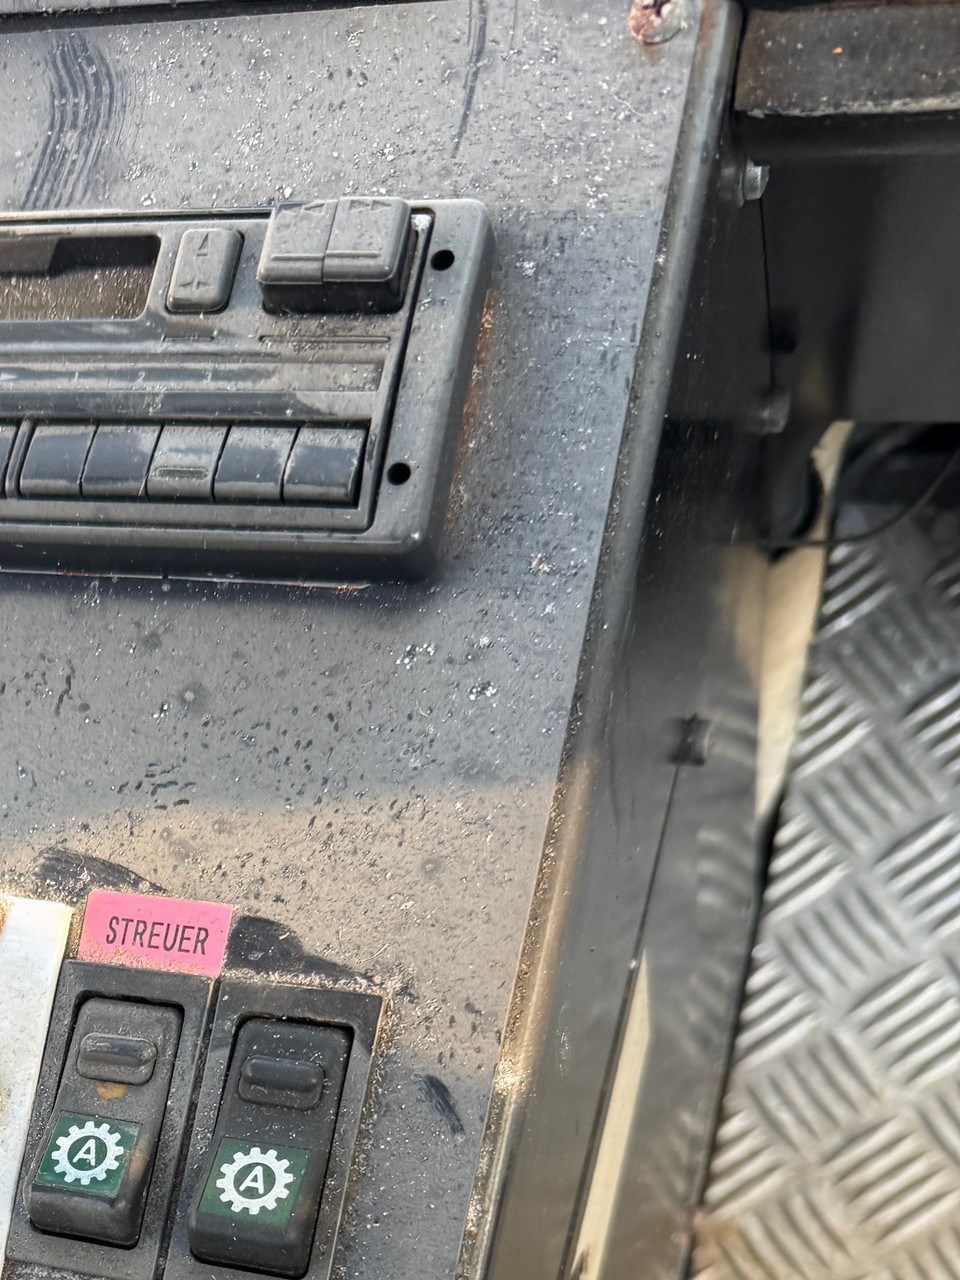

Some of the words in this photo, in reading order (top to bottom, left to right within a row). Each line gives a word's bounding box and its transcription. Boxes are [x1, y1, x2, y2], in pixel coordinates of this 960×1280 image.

[138, 371, 146, 382] 2
[105, 915, 209, 956] STREUER
[73, 1138, 96, 1166] A
[239, 1165, 265, 1195] A
